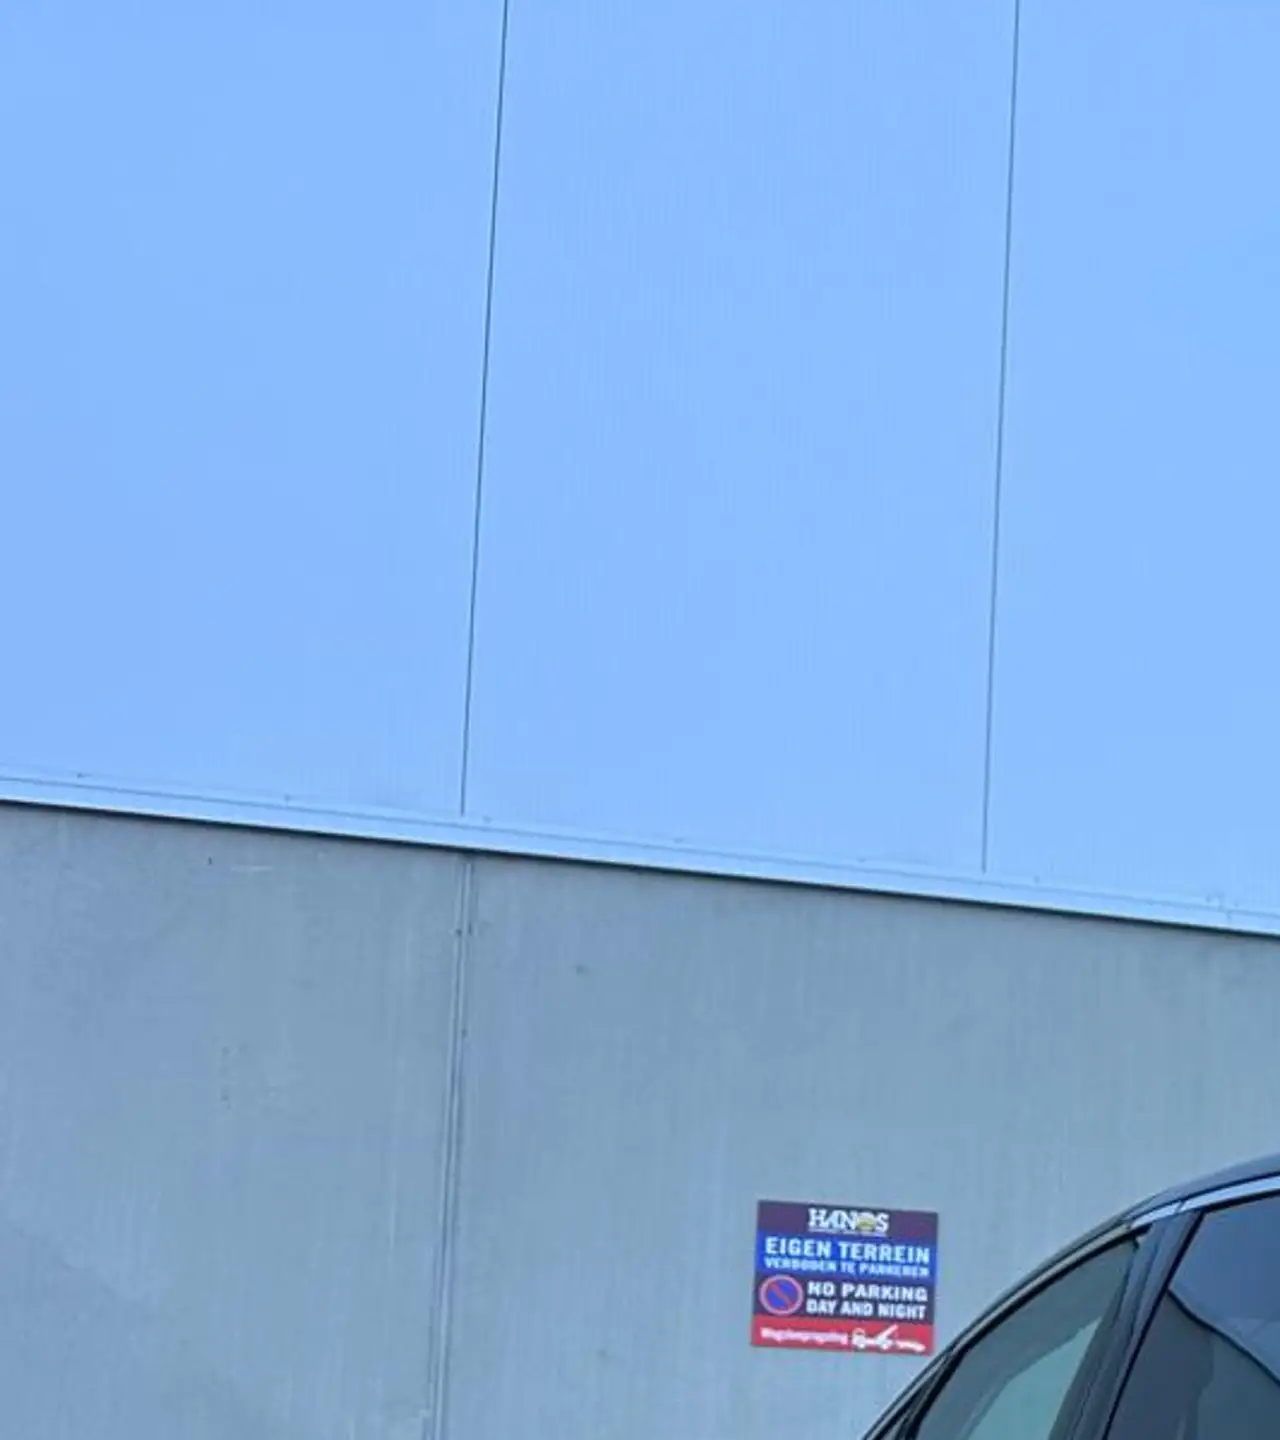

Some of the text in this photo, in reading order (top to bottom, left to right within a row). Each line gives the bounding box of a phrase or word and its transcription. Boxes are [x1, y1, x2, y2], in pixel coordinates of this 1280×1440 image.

[808, 1208, 889, 1233] HANOS
[765, 1236, 930, 1264] EIGEN TERREIN
[807, 1281, 928, 1302] NO PARKING
[806, 1298, 927, 1320] DAY AND NIGHT
